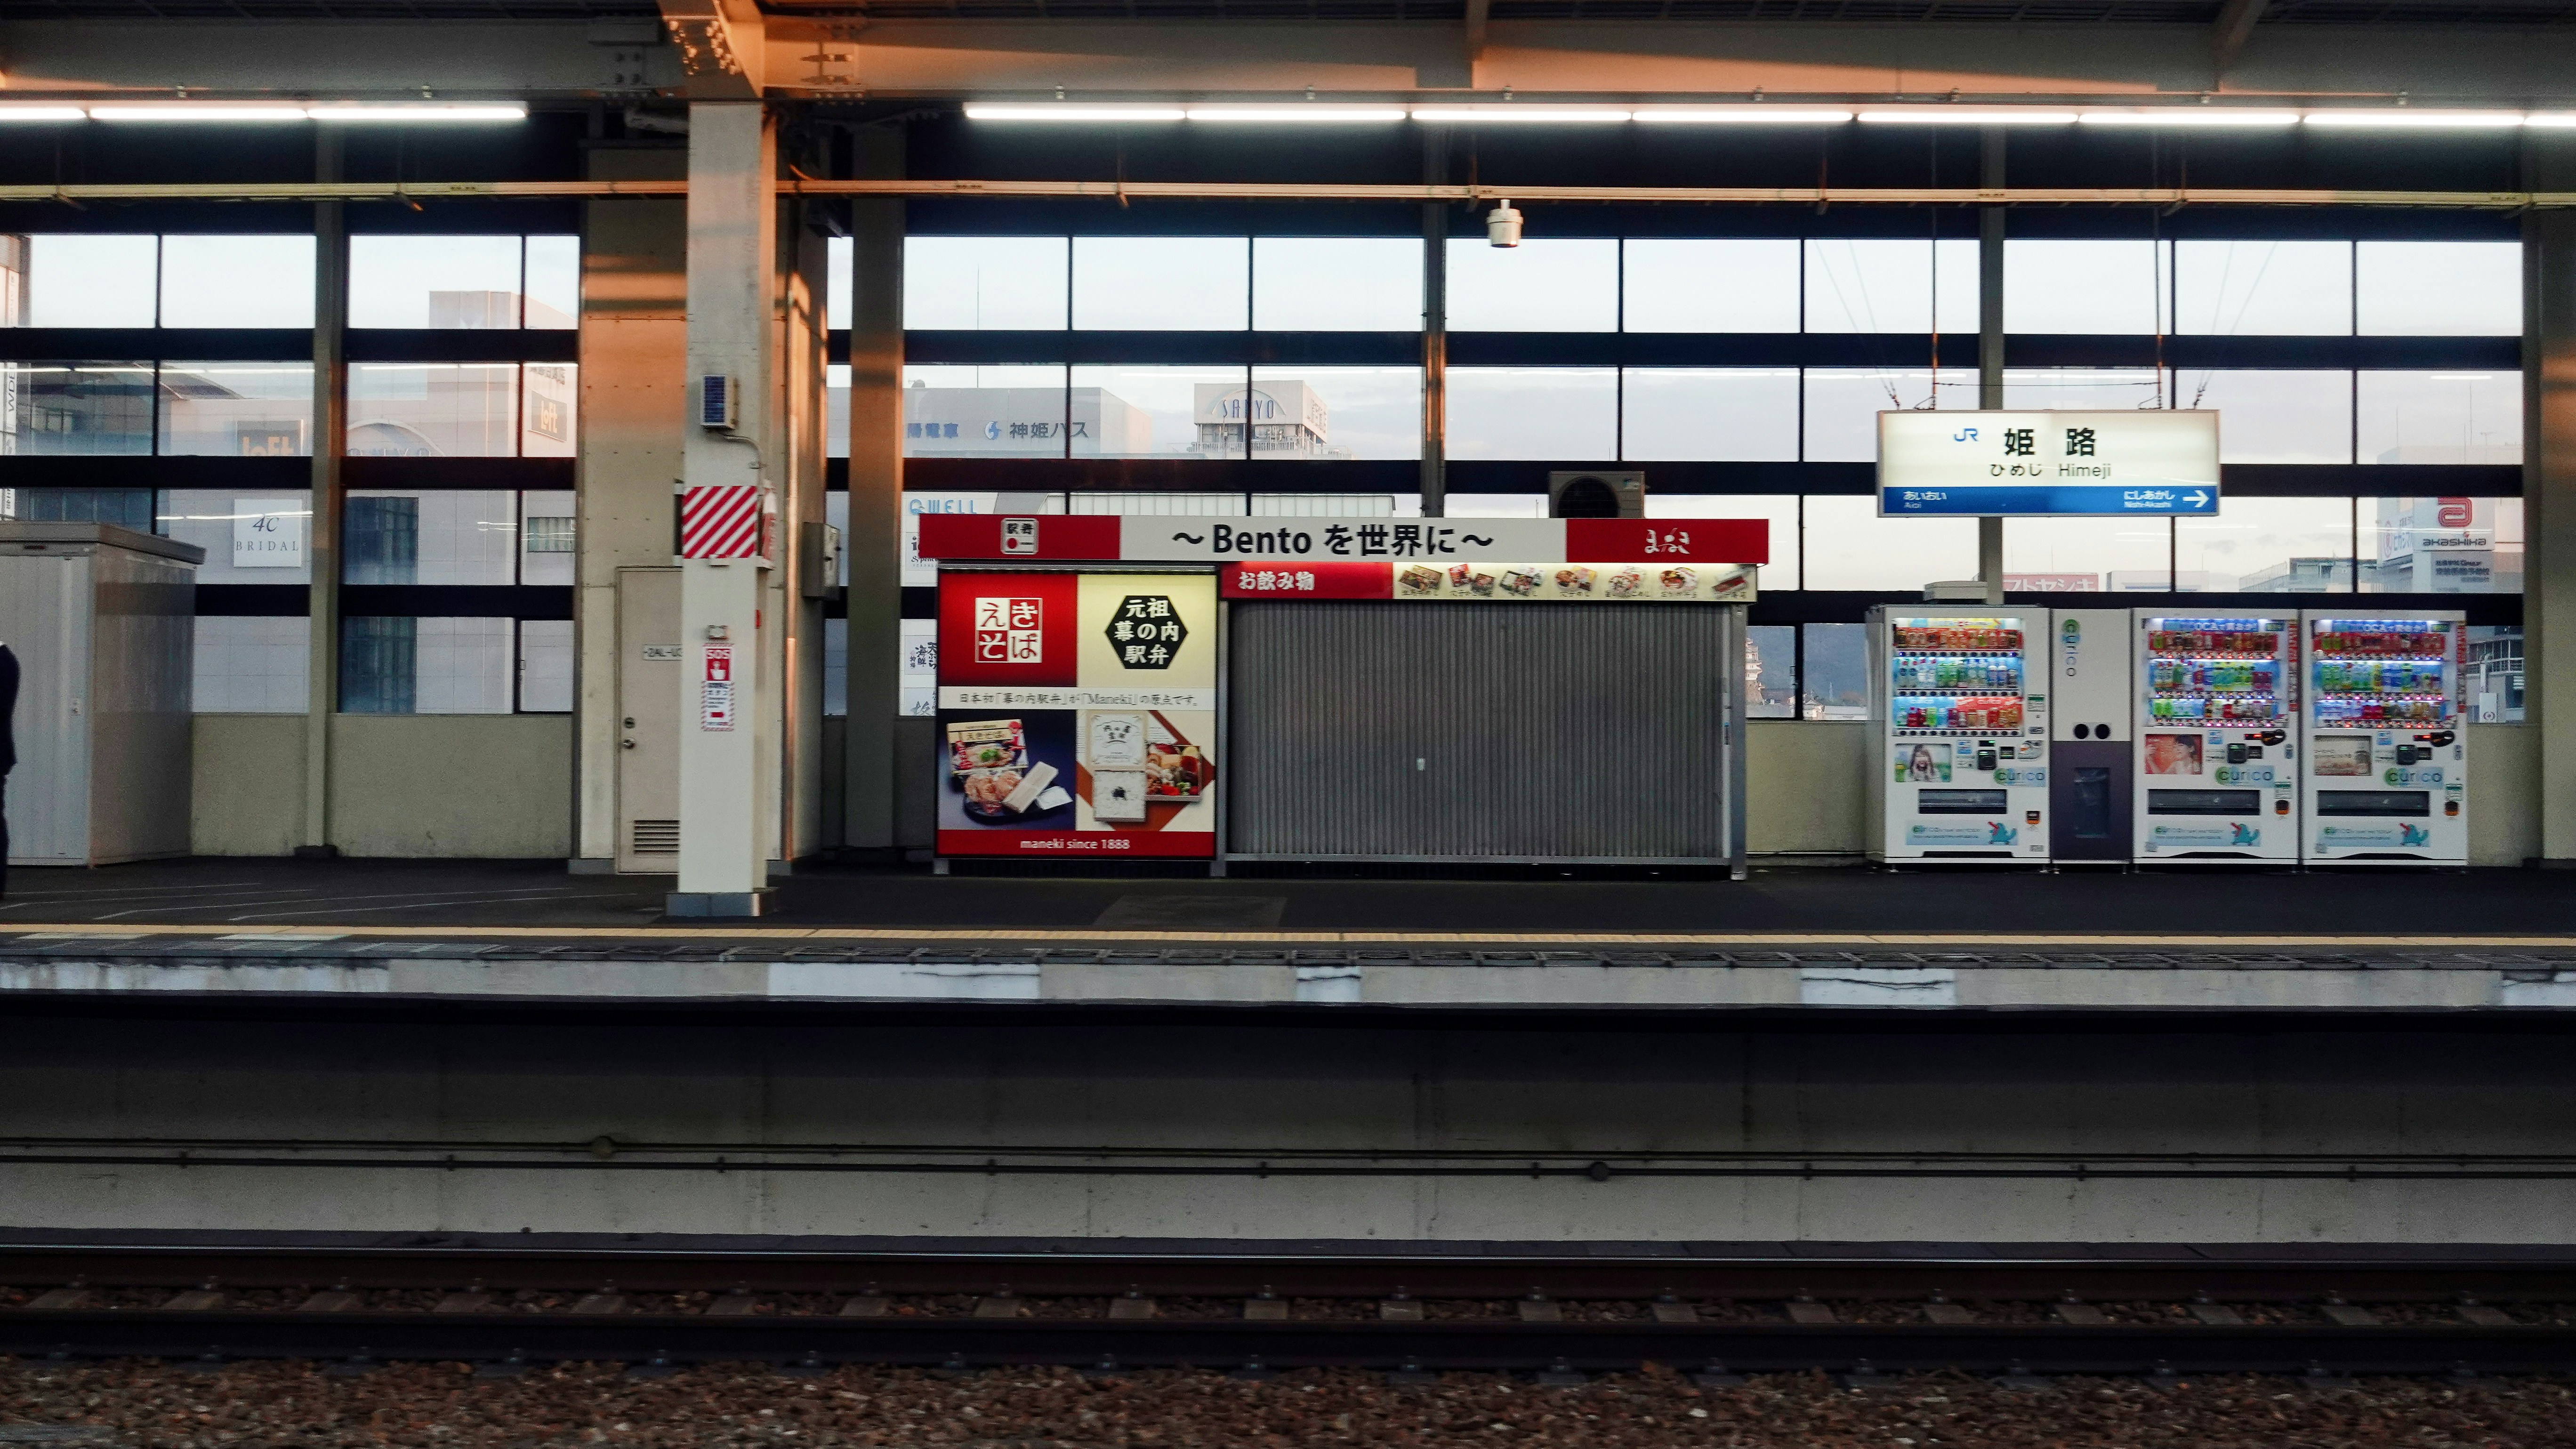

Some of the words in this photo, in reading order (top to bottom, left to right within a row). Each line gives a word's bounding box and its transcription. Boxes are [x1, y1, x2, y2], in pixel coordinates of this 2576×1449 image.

[1954, 428, 1979, 442] JR
[2004, 429, 2096, 456] 姫路
[1990, 464, 2042, 476] ひめじ
[2059, 464, 2111, 477] Himeji
[236, 541, 299, 551] BRIDAL
[1239, 571, 1315, 591] お飲み物
[982, 602, 1038, 628] えき
[1126, 598, 1171, 618] 元祖
[1113, 620, 1180, 642] 幕の内
[706, 649, 730, 659] SOS
[979, 633, 1038, 660] そば
[1124, 645, 1169, 665] 駅弁
[1020, 838, 1064, 848] maneki
[1066, 839, 1098, 849] since
[1101, 839, 1130, 849] 1888
